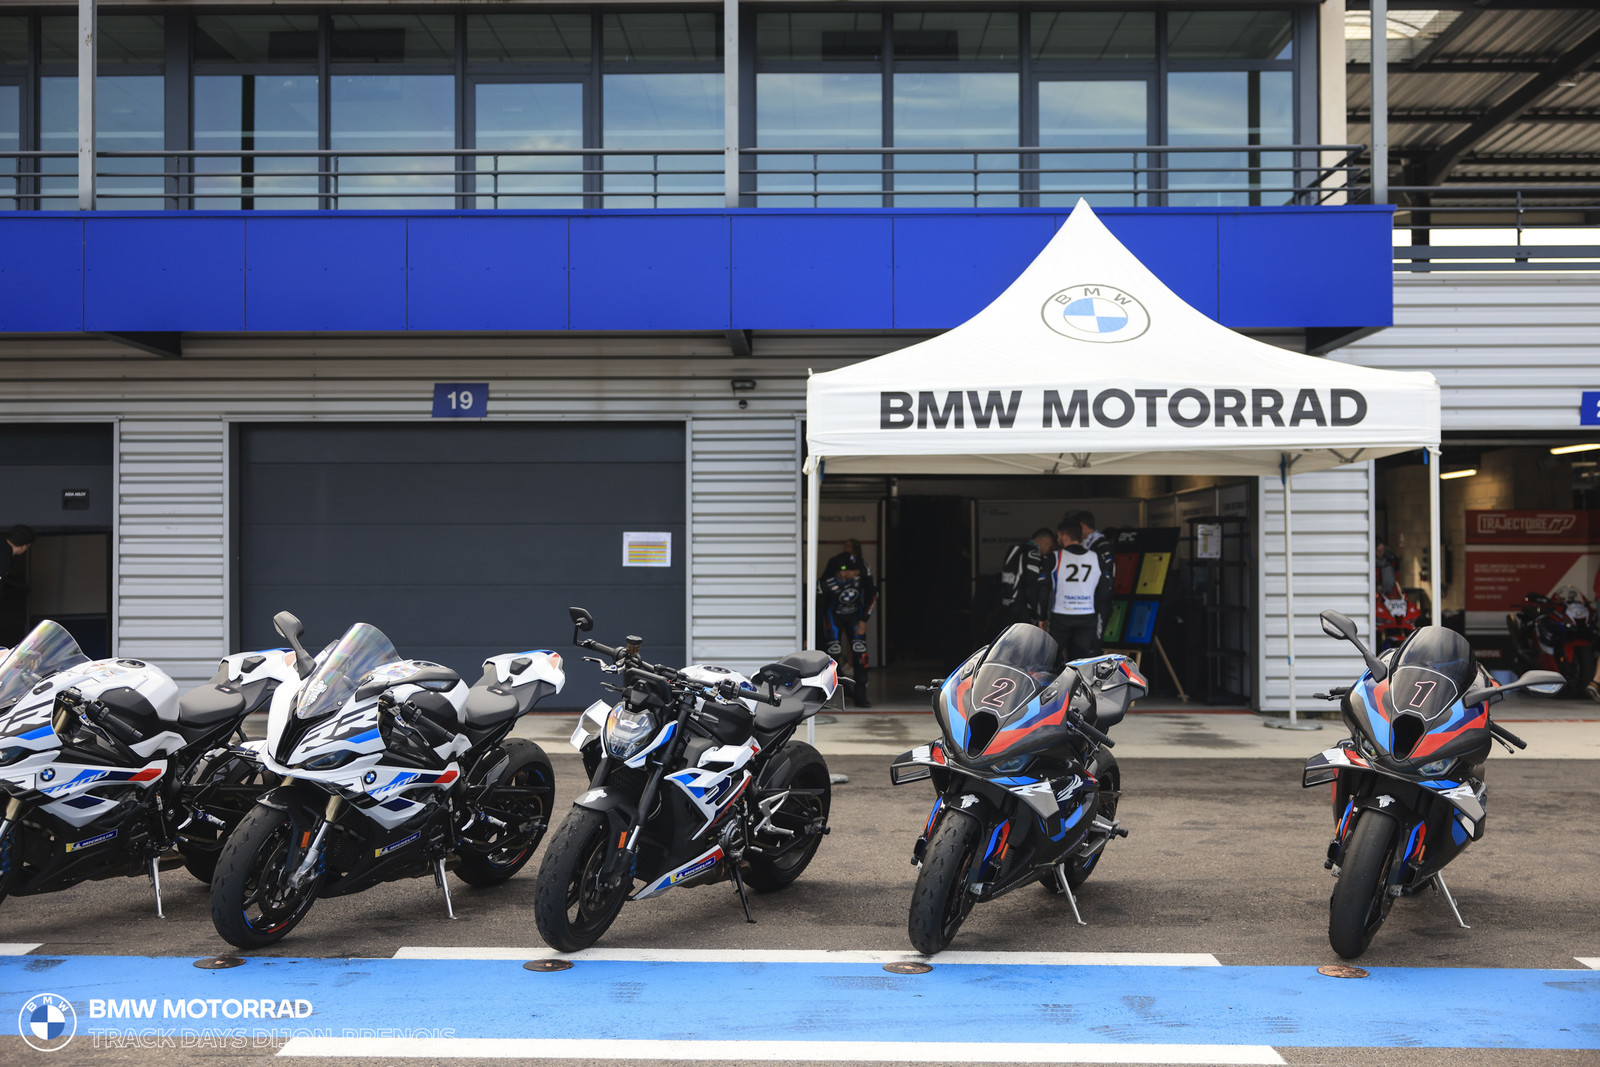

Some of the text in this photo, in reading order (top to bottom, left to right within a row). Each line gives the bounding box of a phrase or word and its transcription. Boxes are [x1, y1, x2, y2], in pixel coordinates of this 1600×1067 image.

[1053, 285, 1134, 307] BMW
[447, 390, 474, 411] 19
[880, 387, 1368, 430] BMW MOTORRAD
[1065, 563, 1092, 582] 27
[981, 677, 1017, 708] 2
[1409, 680, 1437, 708] 1
